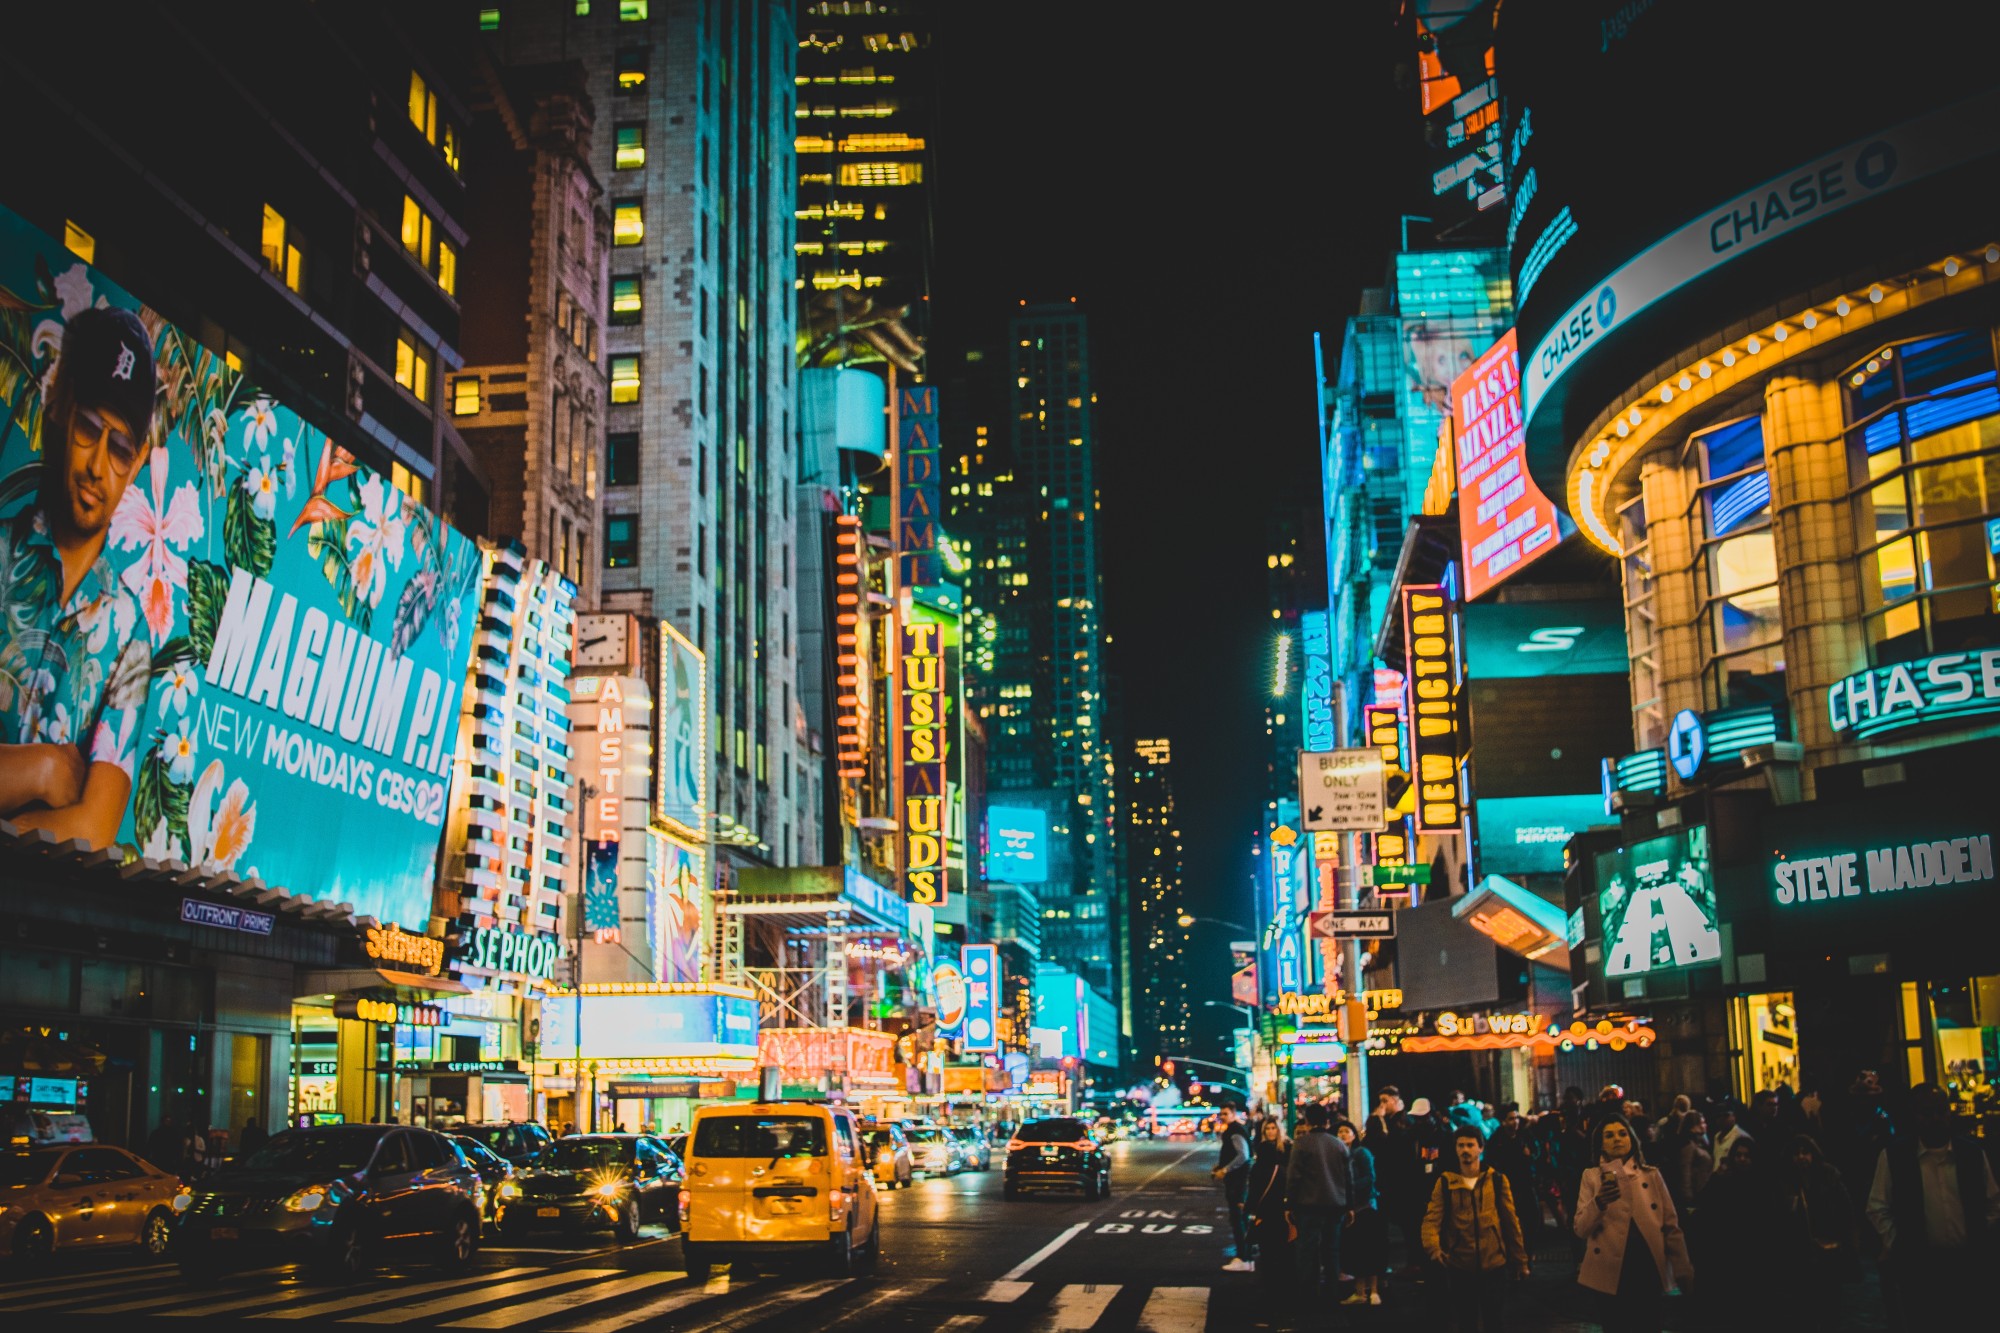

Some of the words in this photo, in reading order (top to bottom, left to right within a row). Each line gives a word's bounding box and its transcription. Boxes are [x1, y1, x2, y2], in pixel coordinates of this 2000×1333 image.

[1600, 0, 1656, 53] Jagua
[1466, 109, 1484, 135] SOLD
[1711, 161, 1848, 254] CHASE
[1541, 306, 1594, 379] CHASE
[903, 388, 936, 586] MADAME
[205, 569, 416, 758] MAGNUM
[403, 665, 455, 778] P.I.
[1411, 594, 1451, 737] VICTORY
[1827, 651, 2000, 732] CHASE
[200, 698, 264, 765] NEW
[263, 726, 375, 798] MONDAYS
[905, 624, 939, 904] TUSSAUD'S
[1319, 755, 1366, 771] BUSES
[1323, 775, 1360, 788] ONLY
[1421, 752, 1456, 826] NEW
[1387, 867, 1397, 883] 7
[1774, 853, 1861, 905] STEVE
[1866, 834, 1994, 893] MADDEN
[184, 902, 240, 926] OUTFRONT
[243, 913, 271, 931] PRIME
[1323, 918, 1346, 929] ONE
[1358, 918, 1384, 929] WAY
[1437, 1011, 1543, 1036] Subway
[1093, 1223, 1215, 1235] BUS
